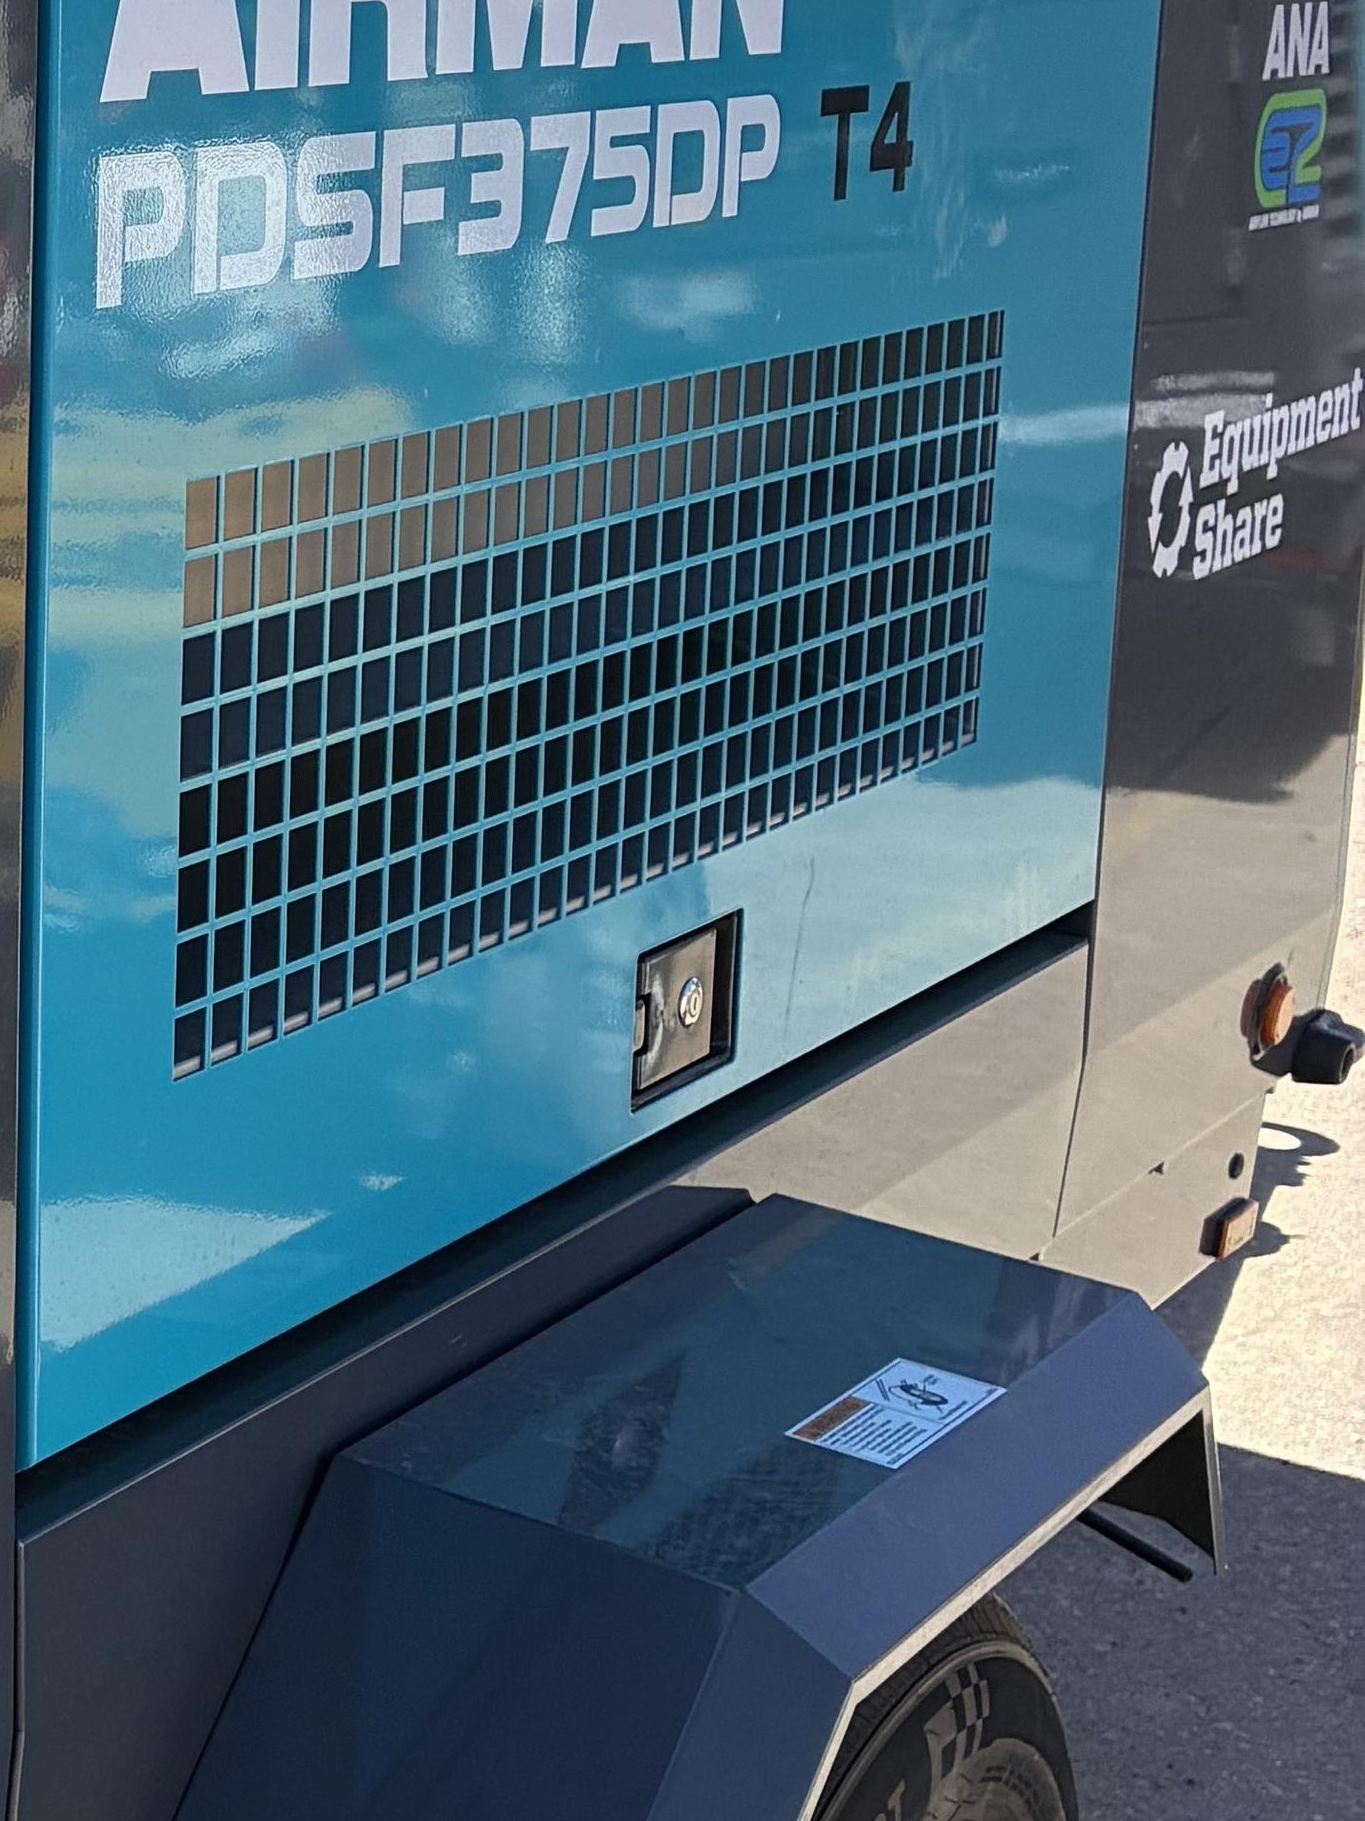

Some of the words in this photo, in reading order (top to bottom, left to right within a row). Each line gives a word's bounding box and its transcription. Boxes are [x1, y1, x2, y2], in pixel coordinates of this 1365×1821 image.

[1262, 0, 1331, 80] ANA
[95, 93, 782, 309] PDSF375DP
[820, 81, 915, 201] T4
[1199, 367, 1364, 496] Equipment
[1193, 493, 1284, 580] Share
